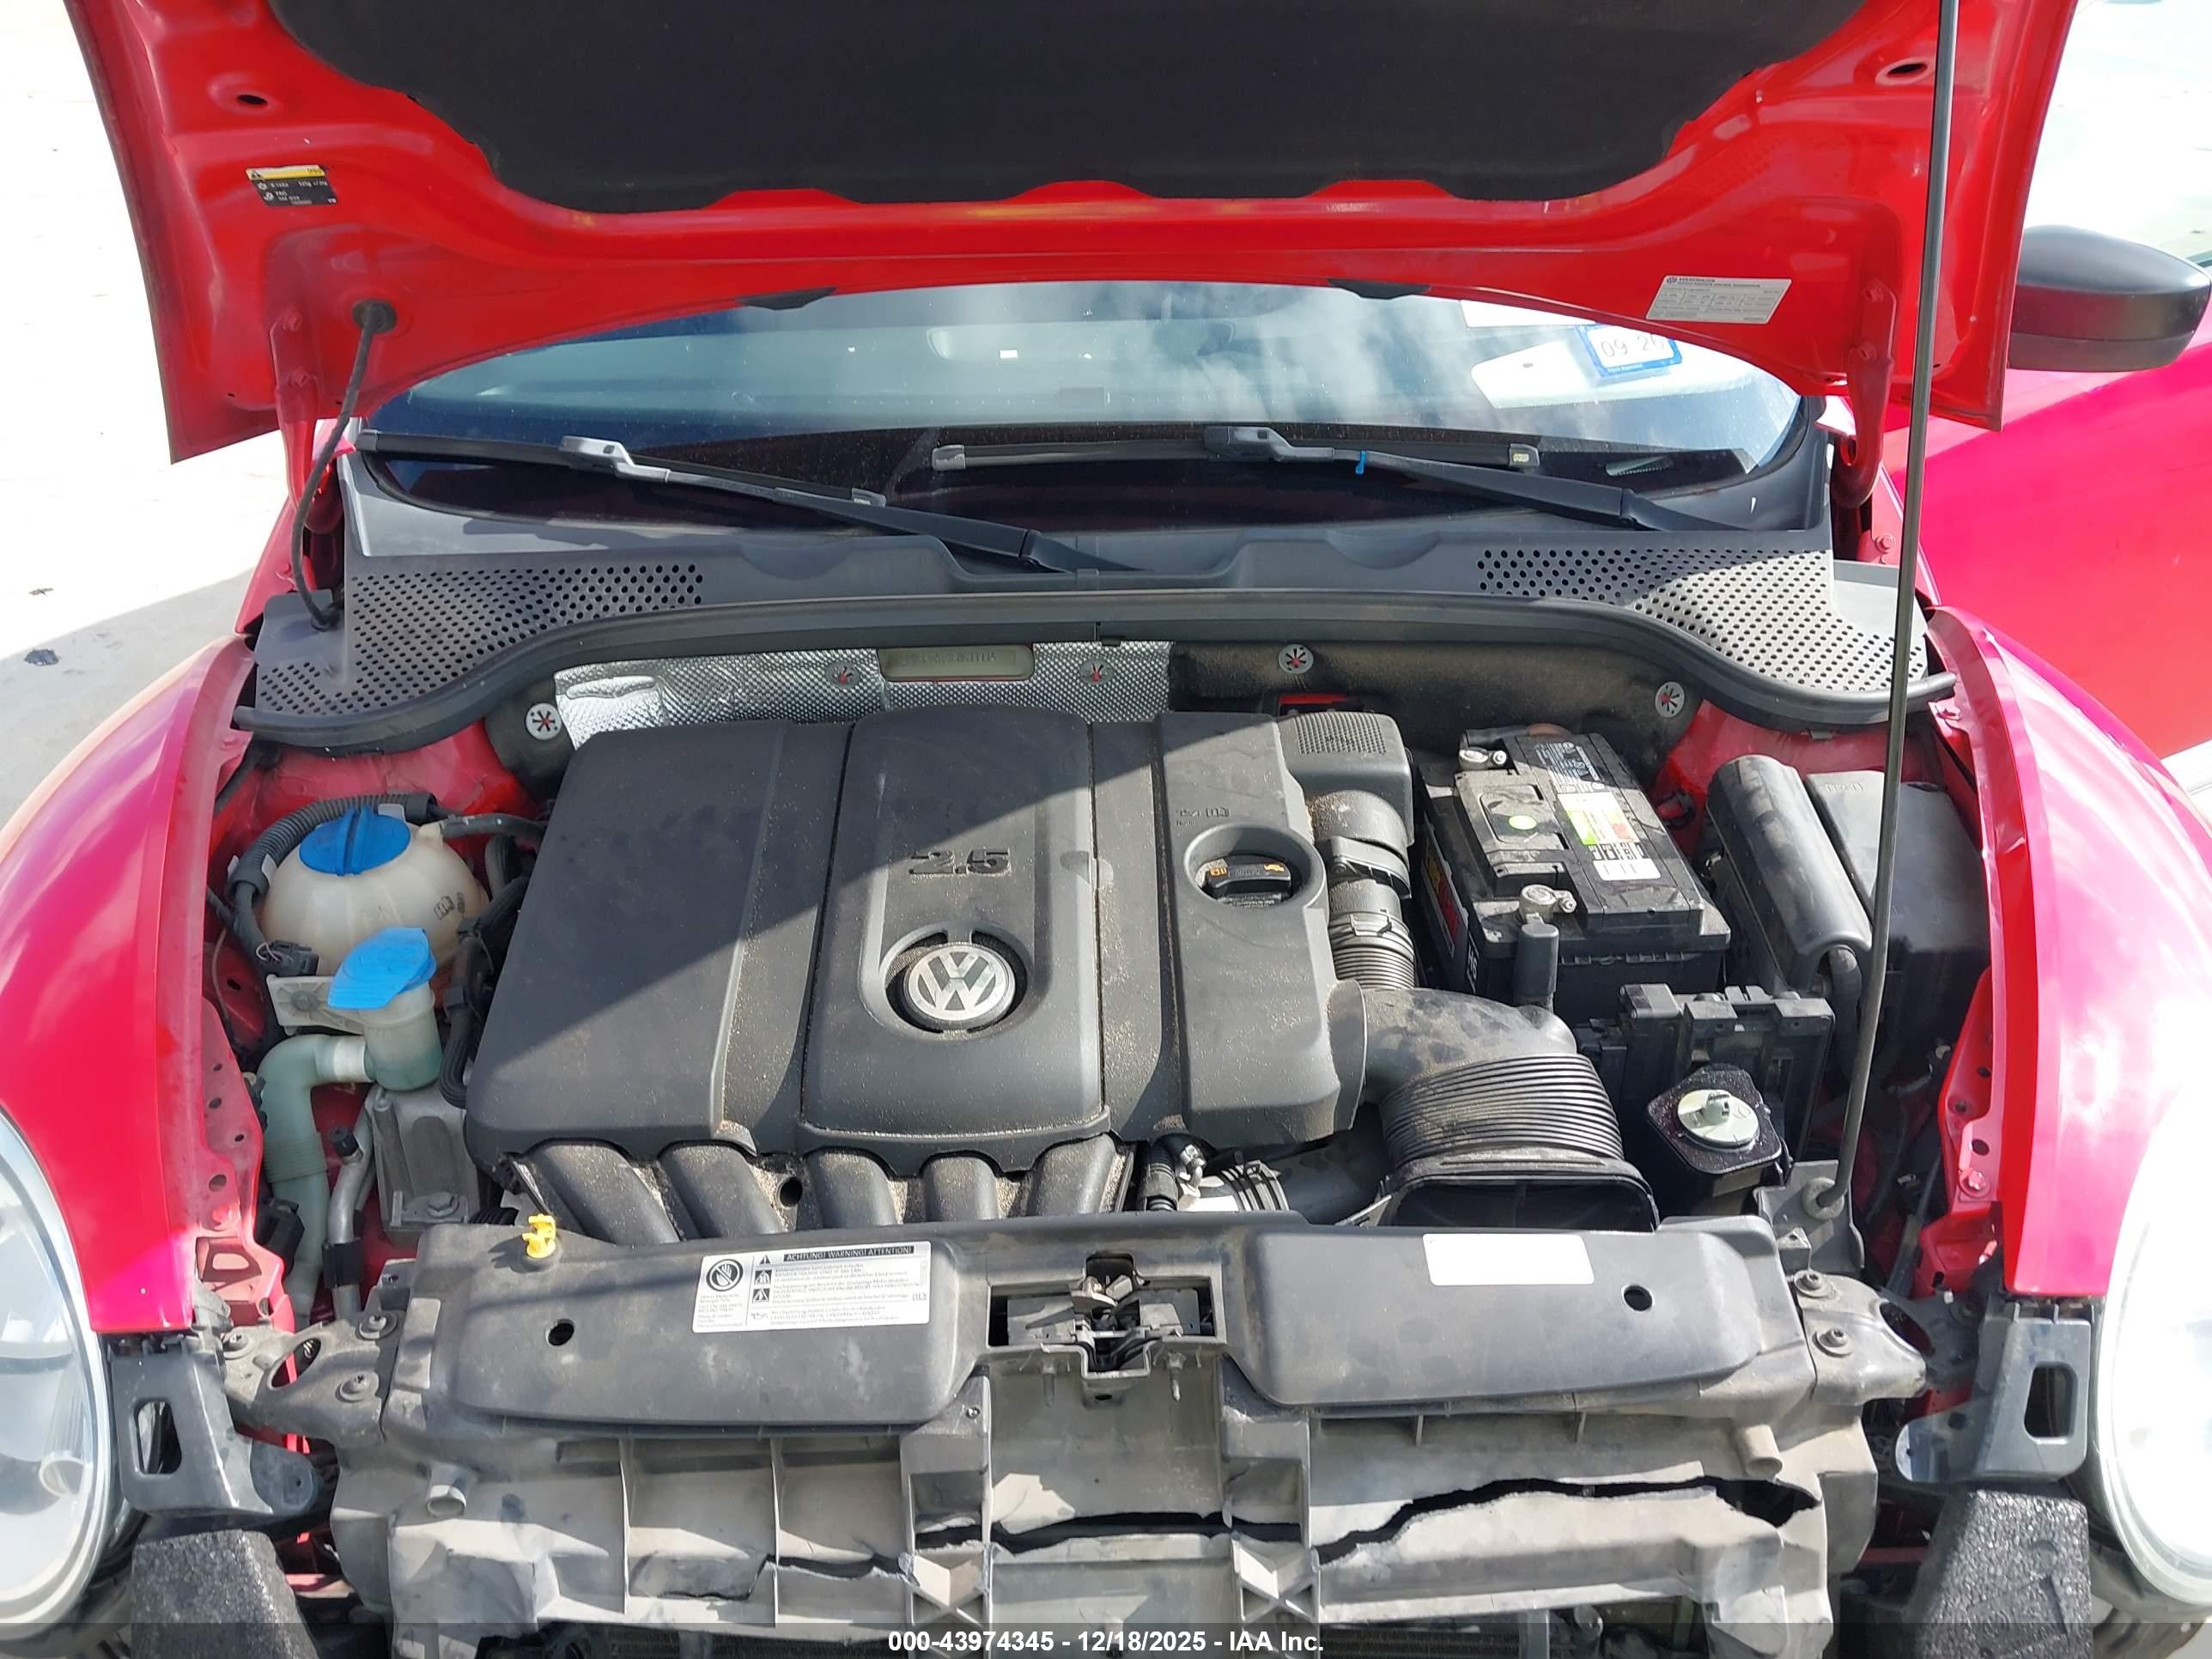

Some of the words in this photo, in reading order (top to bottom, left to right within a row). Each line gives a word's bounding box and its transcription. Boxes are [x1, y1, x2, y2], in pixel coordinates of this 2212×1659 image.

[908, 848, 1012, 877] 2.5
[910, 947, 1012, 1018] VW
[786, 1250, 826, 1262] ACHTUNG!
[827, 1248, 866, 1260] WARNING!
